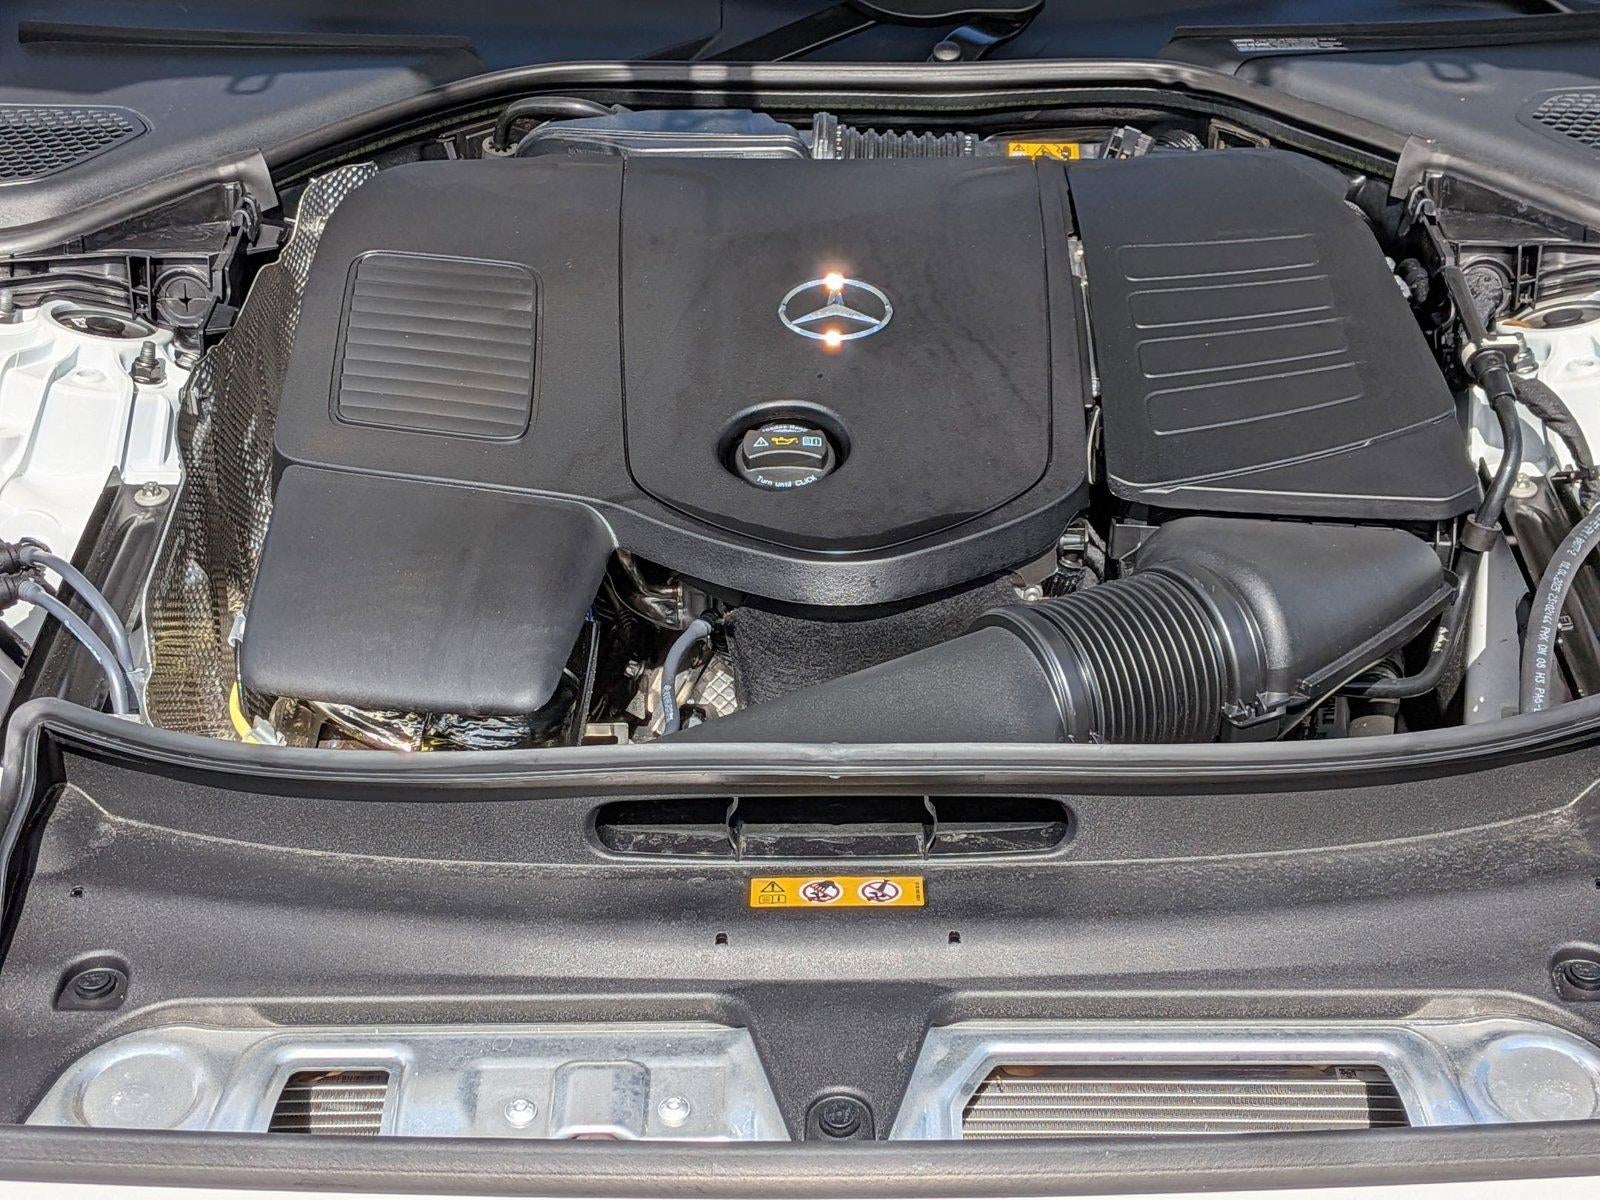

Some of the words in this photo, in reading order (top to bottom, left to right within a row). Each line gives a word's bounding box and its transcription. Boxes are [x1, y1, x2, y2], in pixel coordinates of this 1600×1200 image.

[756, 475, 773, 486] Turn
[775, 480, 792, 488] until
[794, 474, 818, 487] CLICK
